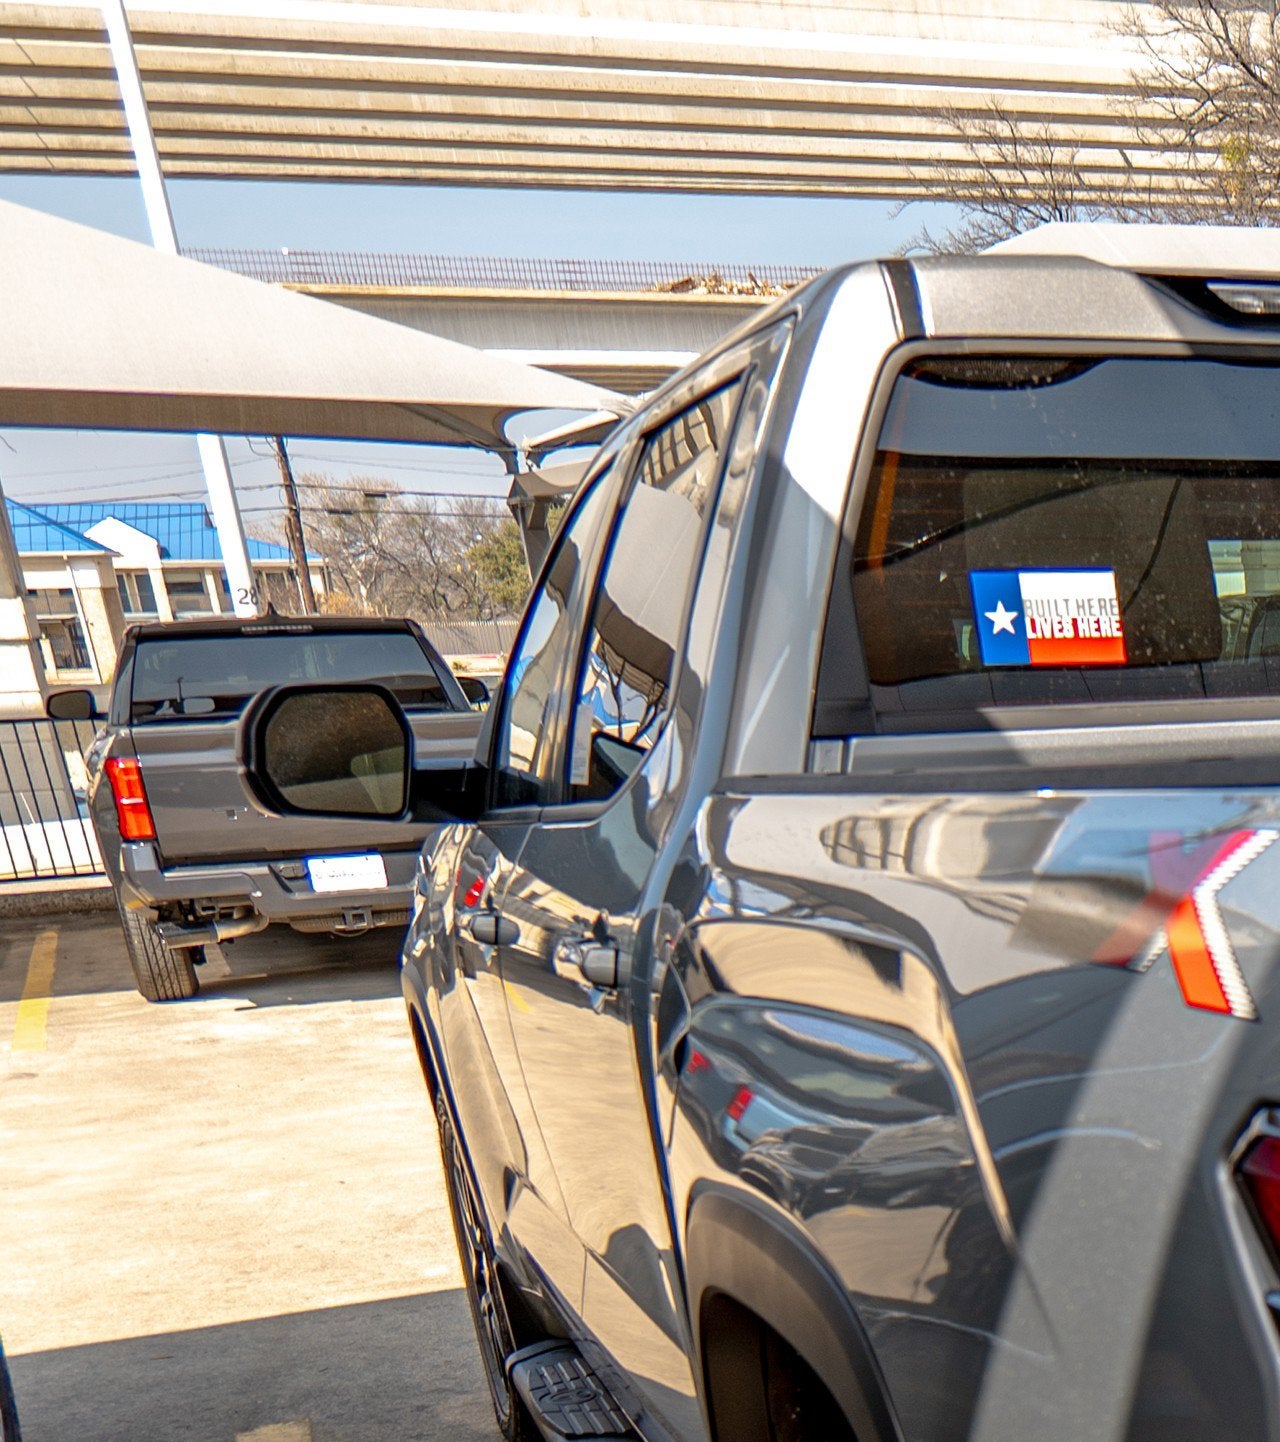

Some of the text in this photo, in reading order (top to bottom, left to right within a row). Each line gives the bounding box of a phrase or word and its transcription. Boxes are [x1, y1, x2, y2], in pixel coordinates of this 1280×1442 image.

[1023, 597, 1120, 618] BUILT HERE
[1025, 616, 1123, 640] LIVES HERE
